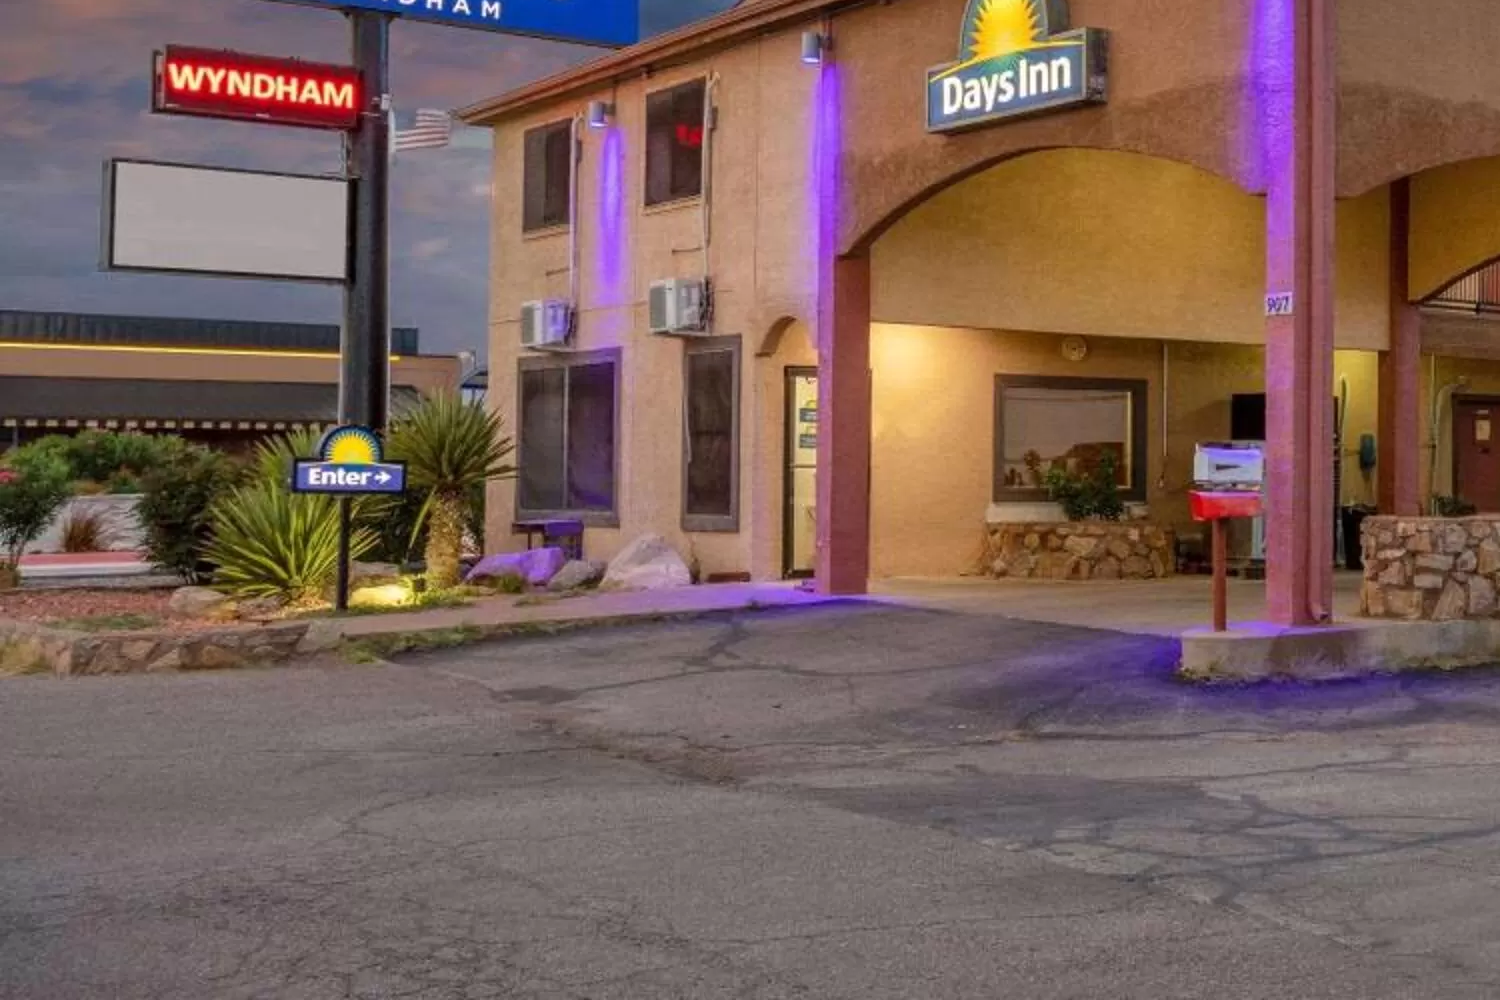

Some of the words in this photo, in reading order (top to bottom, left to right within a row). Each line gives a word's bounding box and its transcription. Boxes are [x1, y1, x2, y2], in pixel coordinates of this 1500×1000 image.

[167, 62, 354, 109] WYNDHAM
[943, 70, 1015, 115] Days
[1019, 56, 1072, 99] Inn
[1267, 296, 1289, 313] 907
[308, 467, 373, 486] Enter
